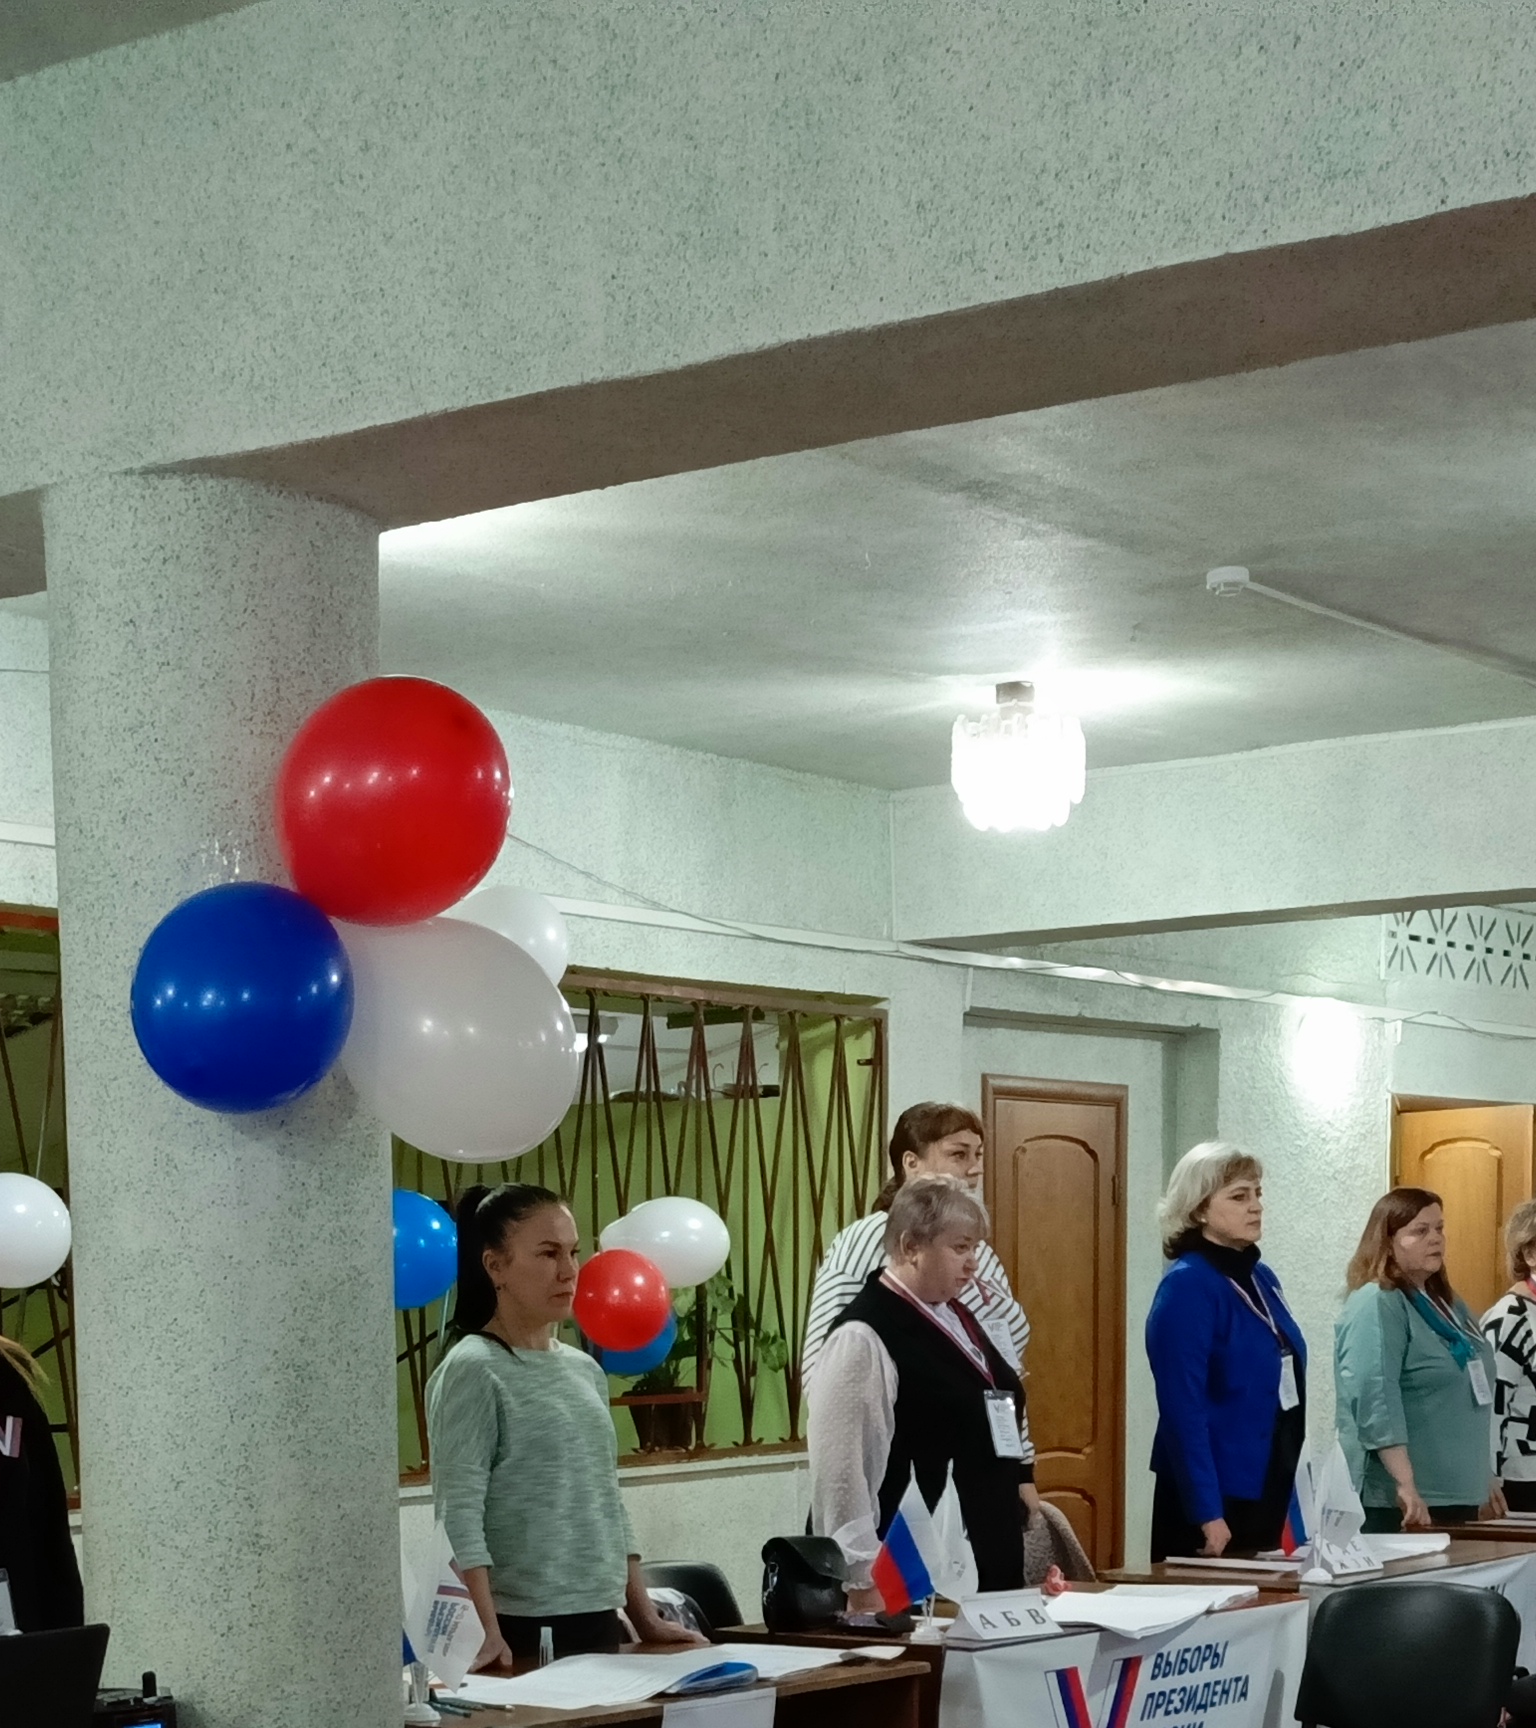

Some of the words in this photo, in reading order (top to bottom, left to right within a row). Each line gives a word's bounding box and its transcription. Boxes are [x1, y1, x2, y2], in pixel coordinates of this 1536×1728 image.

[978, 1613, 998, 1630] А
[1000, 1610, 1022, 1627] Б
[1025, 1608, 1047, 1625] В
[1150, 1640, 1229, 1681] ВЫБОРЫ
[1140, 1674, 1250, 1721] ПРЕЗИДЕНТА
